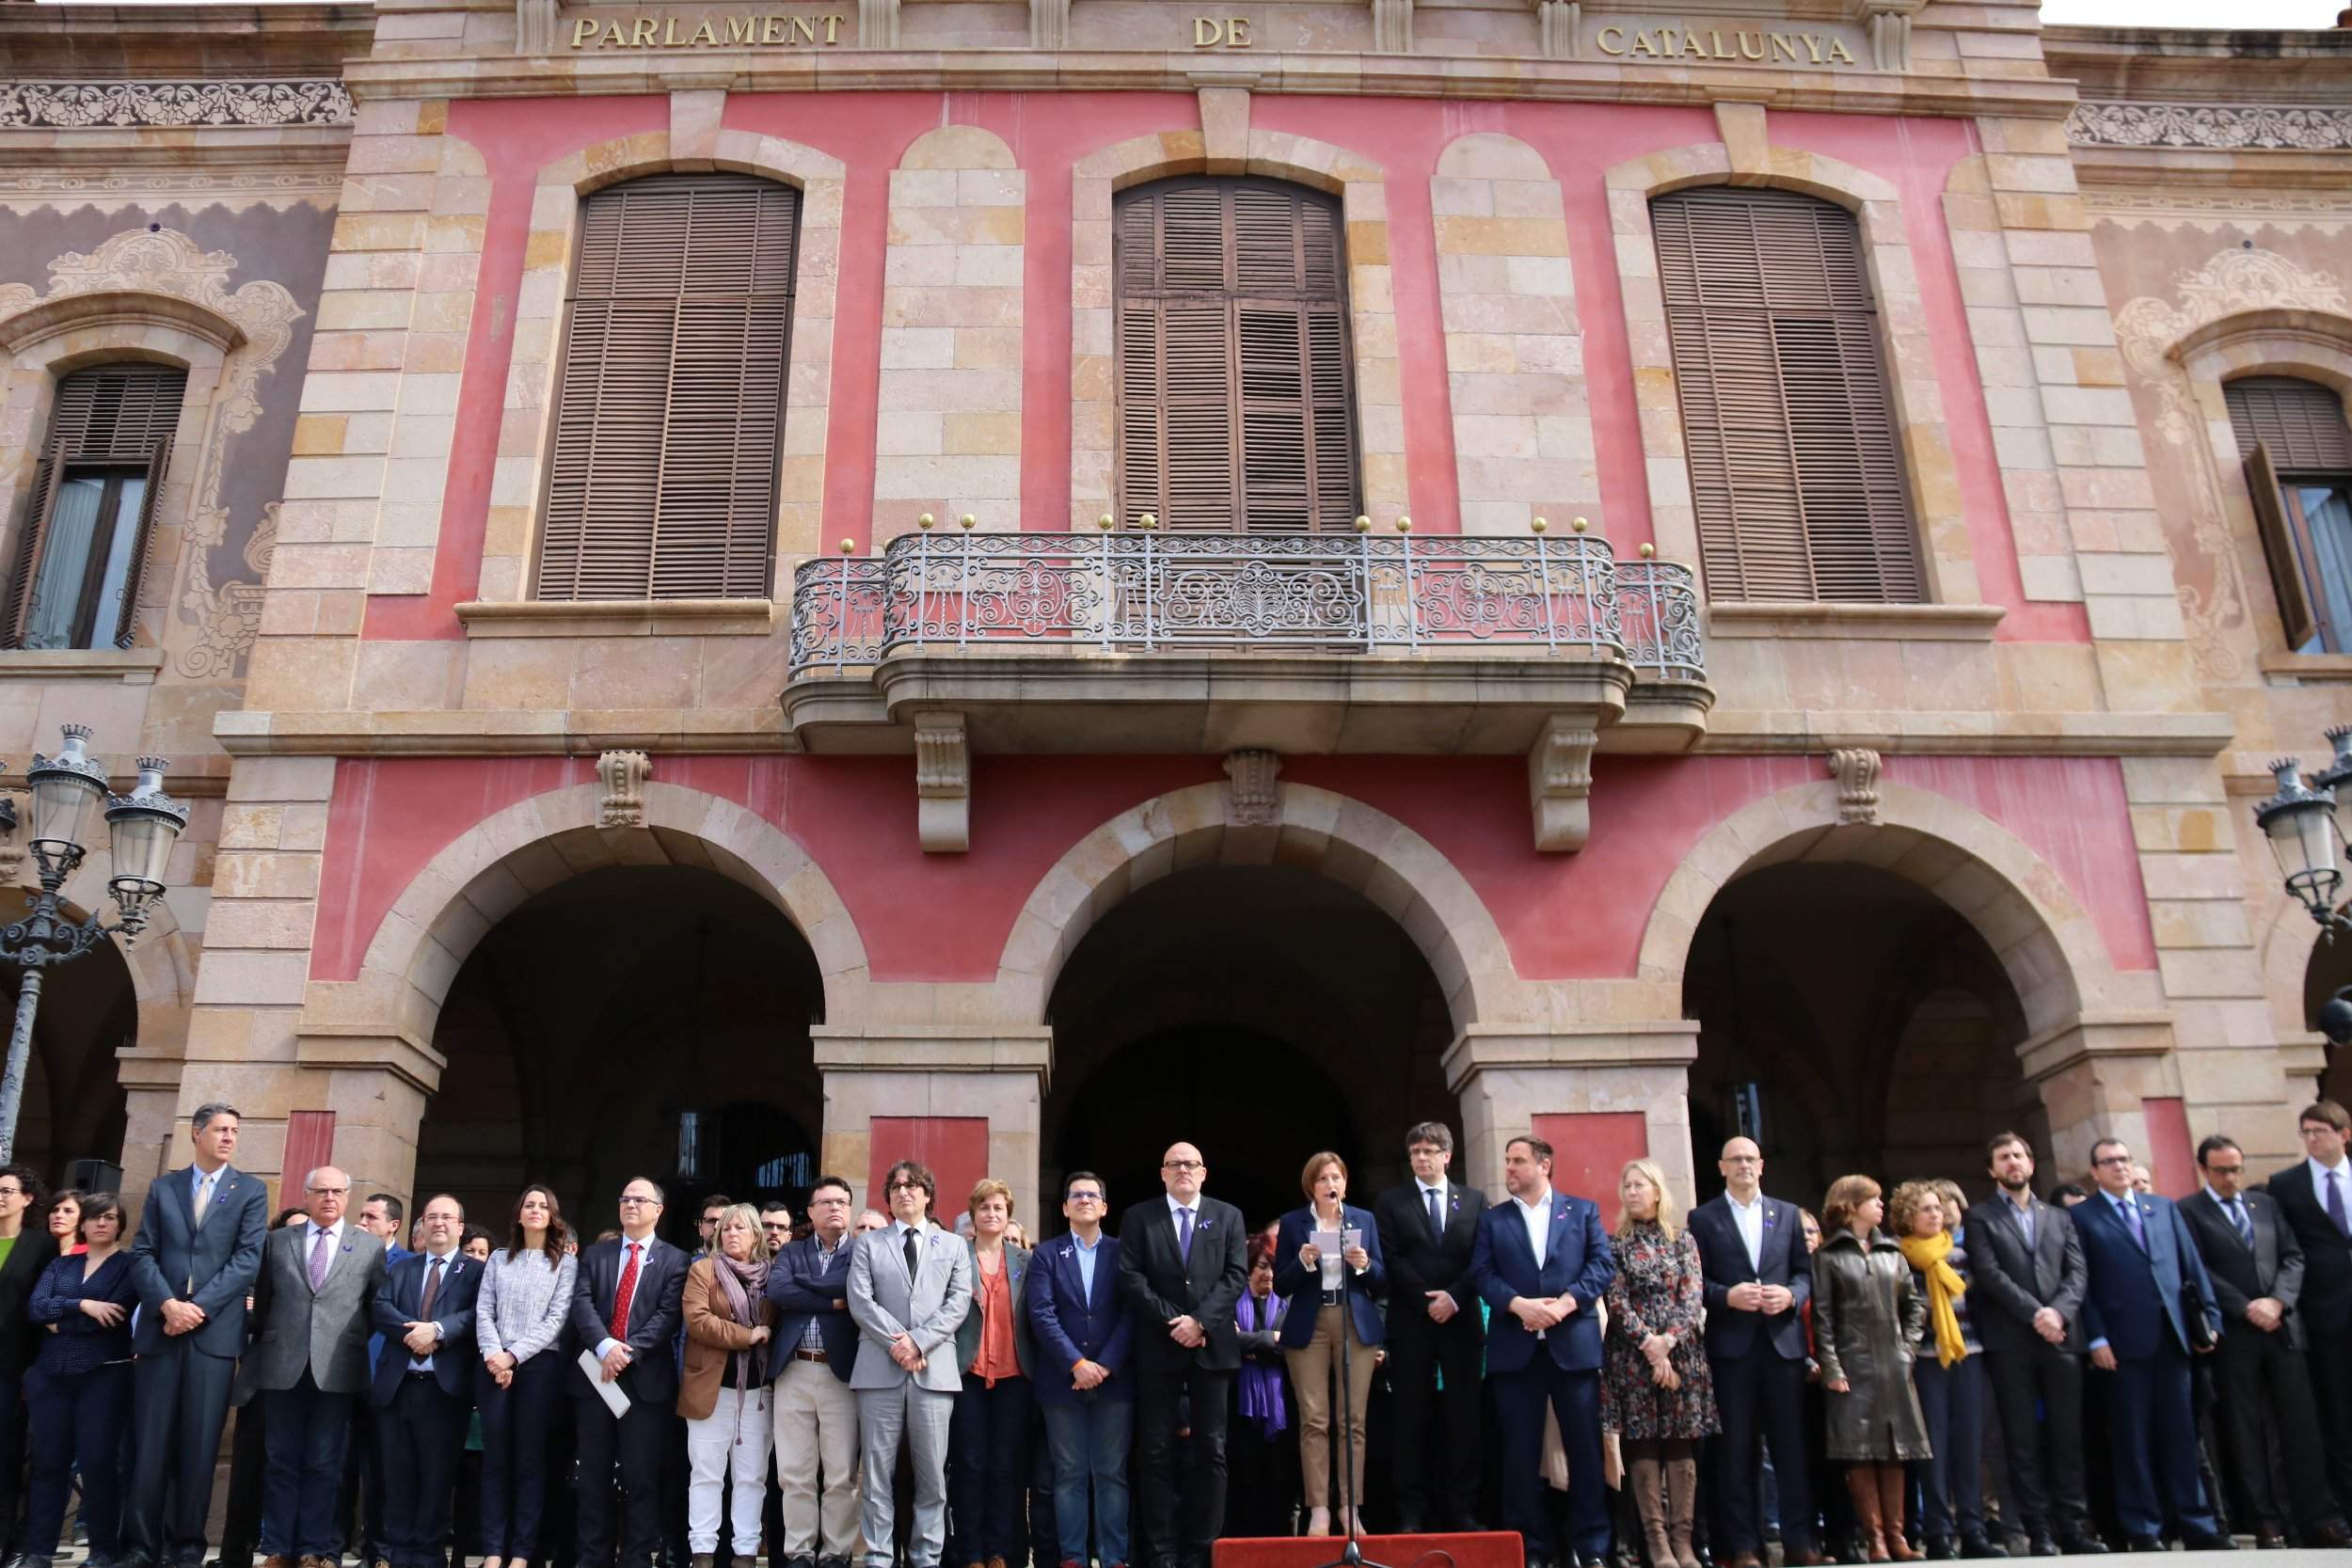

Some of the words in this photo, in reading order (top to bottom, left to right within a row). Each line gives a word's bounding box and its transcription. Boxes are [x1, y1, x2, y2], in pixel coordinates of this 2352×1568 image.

[570, 14, 844, 48] PARLAMENT
[1193, 17, 1251, 48] DE
[1597, 26, 1855, 64] CATALUNYA
